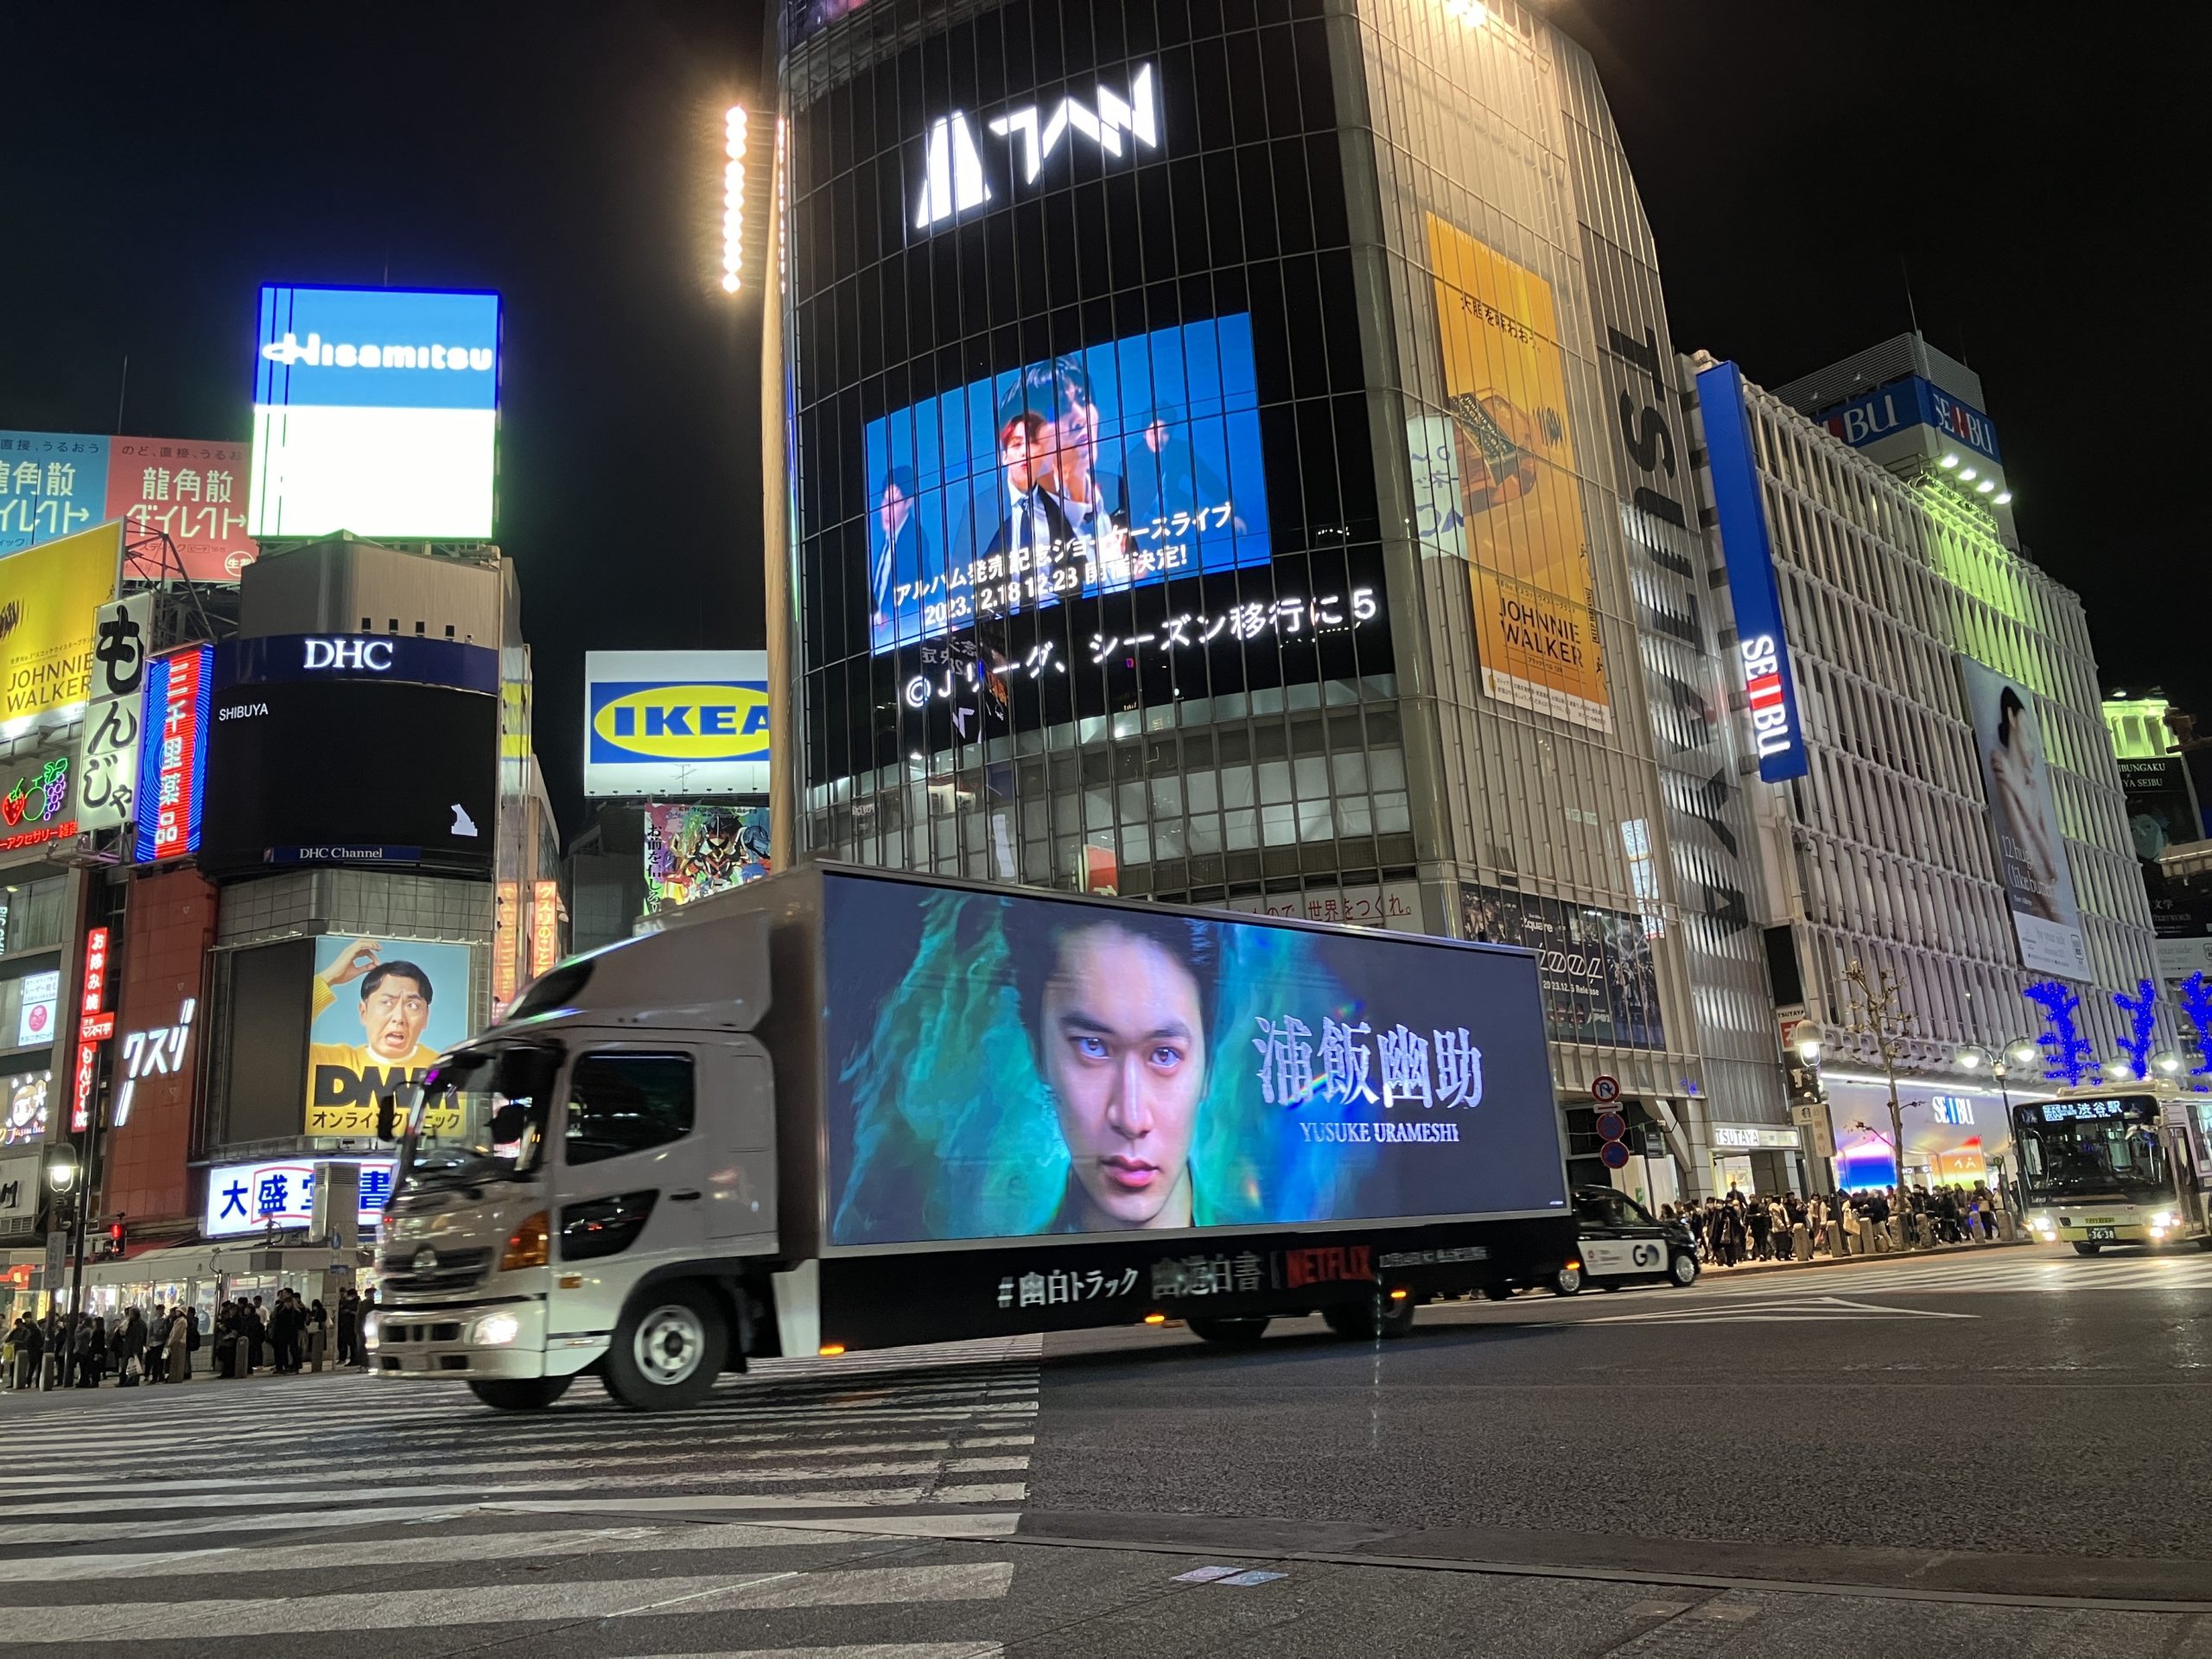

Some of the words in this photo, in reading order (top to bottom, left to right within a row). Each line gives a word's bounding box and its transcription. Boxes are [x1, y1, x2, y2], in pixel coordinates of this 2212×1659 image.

[1933, 393, 1994, 455] SEIBU
[143, 467, 234, 503] 龍角散
[126, 504, 247, 540] ダイレクト
[925, 581, 1021, 626] 2023.2.18
[1499, 597, 1581, 645] JOHNNIE
[303, 639, 394, 671] DHC
[1500, 620, 1584, 669] WALKER
[7, 652, 94, 693] JOHNNIE
[7, 674, 92, 713] WALKER
[83, 604, 145, 818] もんじゃ
[1740, 634, 1792, 759] SEIBU
[219, 703, 270, 721] SHIBUYA
[613, 705, 771, 737] IKEA
[154, 662, 190, 845] 三千里薬品
[300, 848, 328, 860] DHC
[331, 847, 384, 860] Channel
[1307, 893, 1412, 922] 世界をつくれ。
[1777, 1009, 1805, 1019] TSUTAYA
[1251, 1014, 1483, 1109] 浦飯幽助
[312, 1111, 461, 1130] オンライクニック
[1932, 1096, 1975, 1125] SEIBU
[1300, 1122, 1370, 1142] YUSUKE
[1373, 1122, 1459, 1143] URAMESHI
[1714, 1129, 1759, 1145] TSUTAYA
[1632, 1243, 1660, 1268] GO
